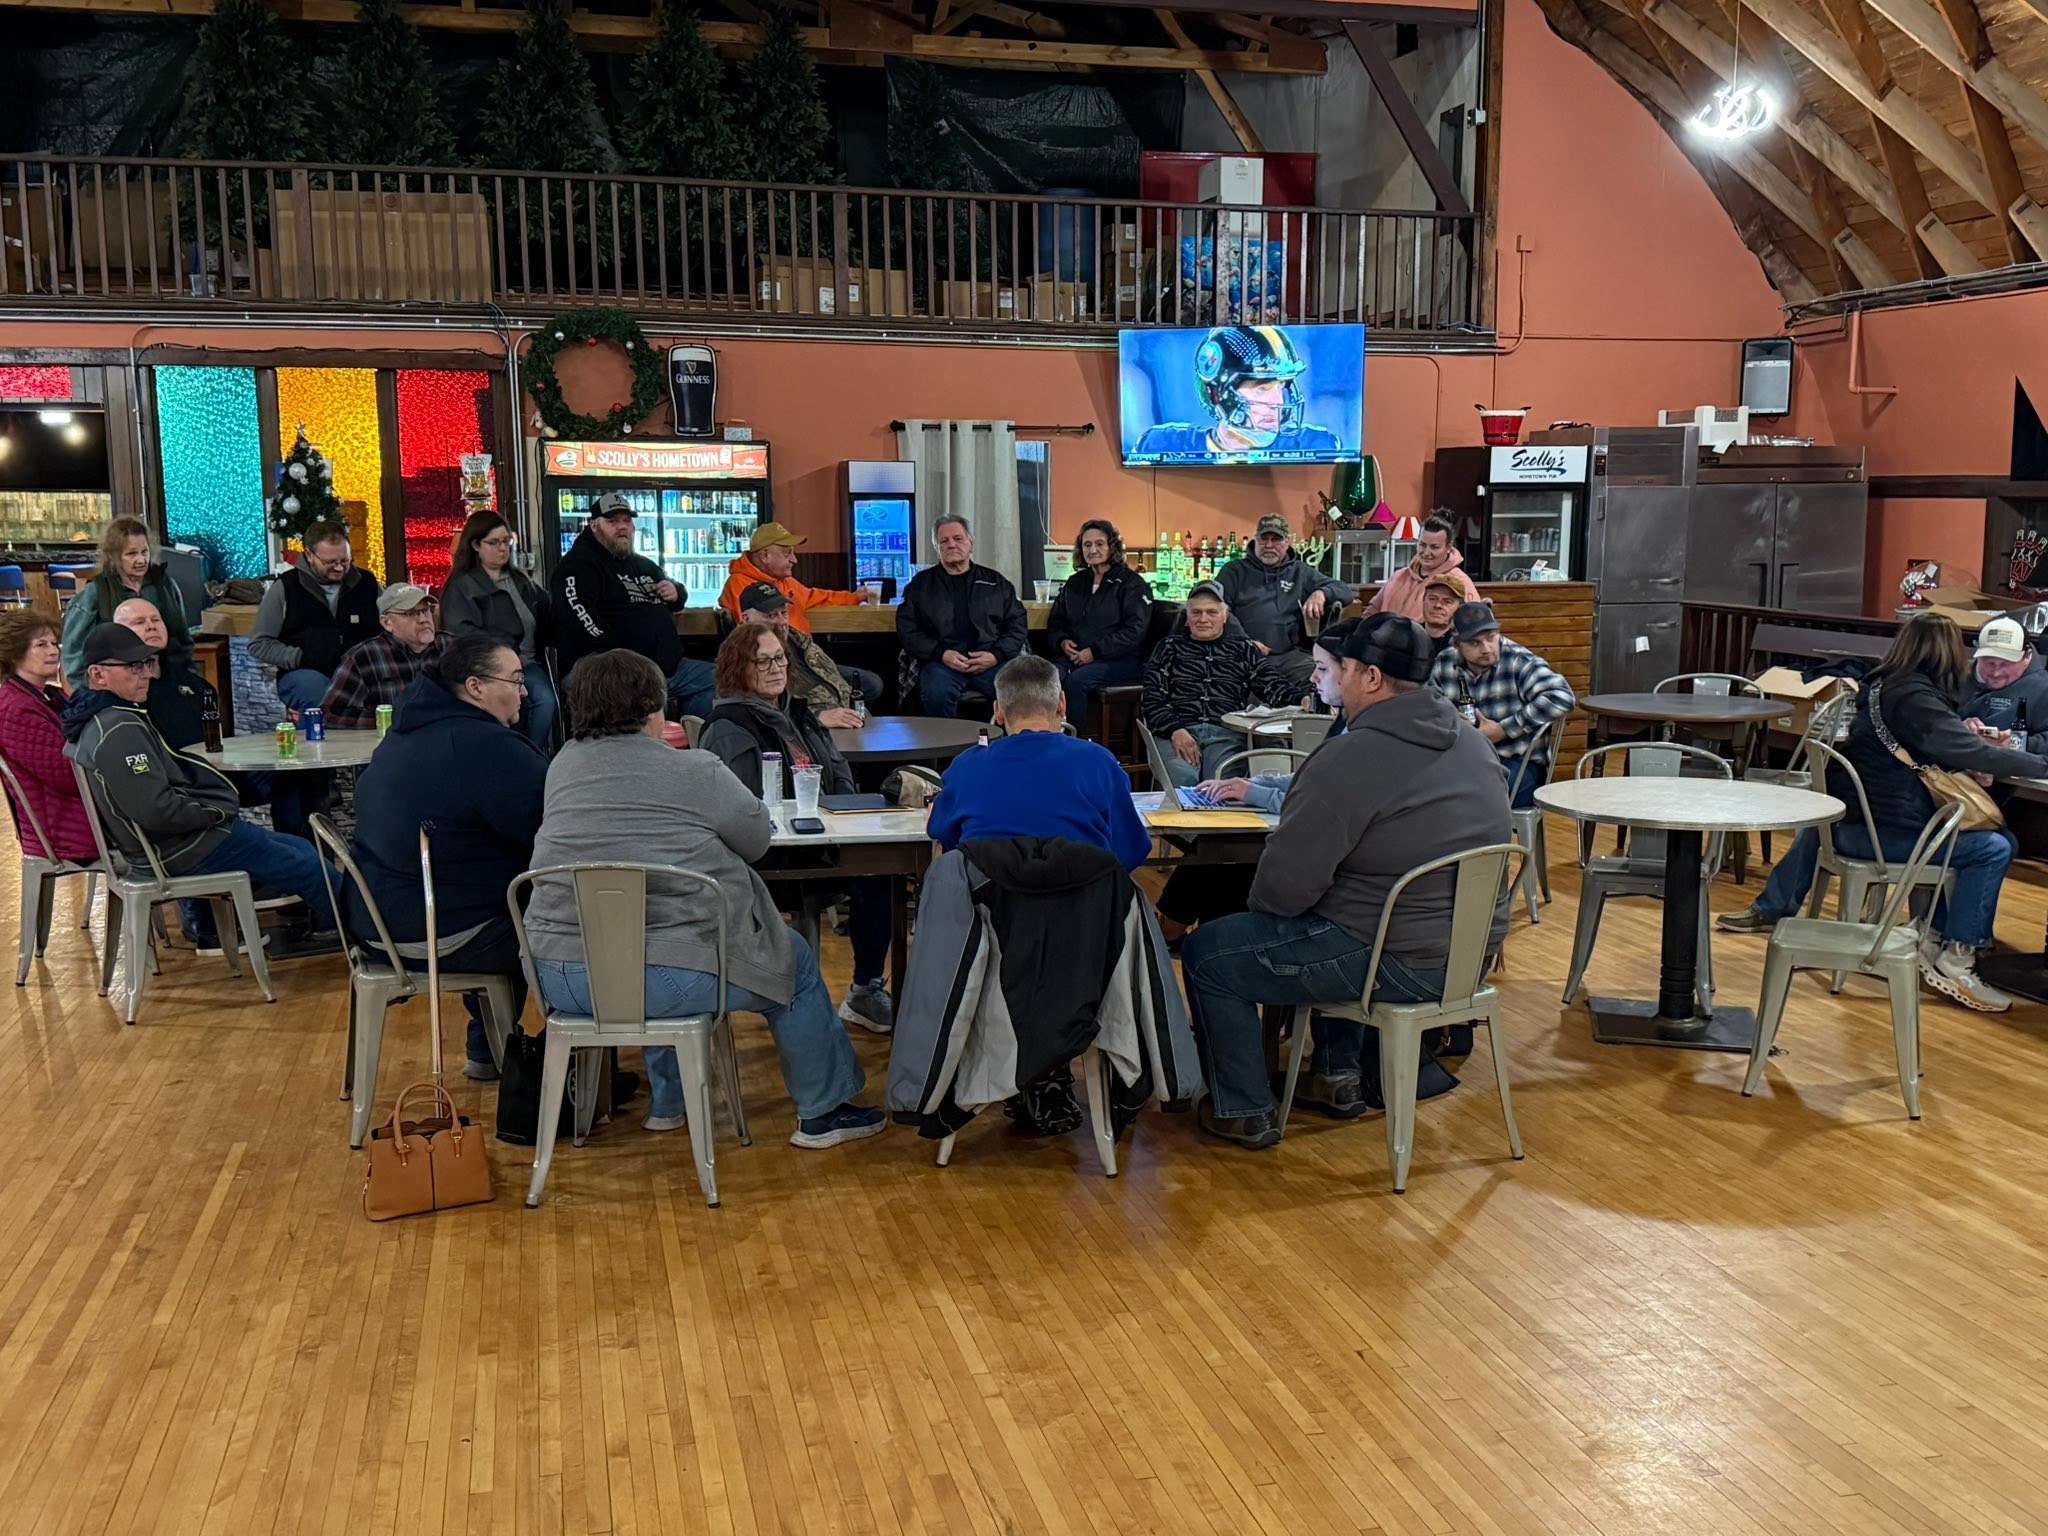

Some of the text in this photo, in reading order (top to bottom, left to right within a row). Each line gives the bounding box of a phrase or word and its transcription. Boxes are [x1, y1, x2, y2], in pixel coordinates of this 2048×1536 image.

[675, 373, 711, 385] GUINNESS
[597, 449, 720, 469] SCOLLY'S HOMETOWN
[1511, 449, 1566, 472] Scolly's
[564, 575, 605, 638] POLARIS
[125, 753, 149, 766] FXR
